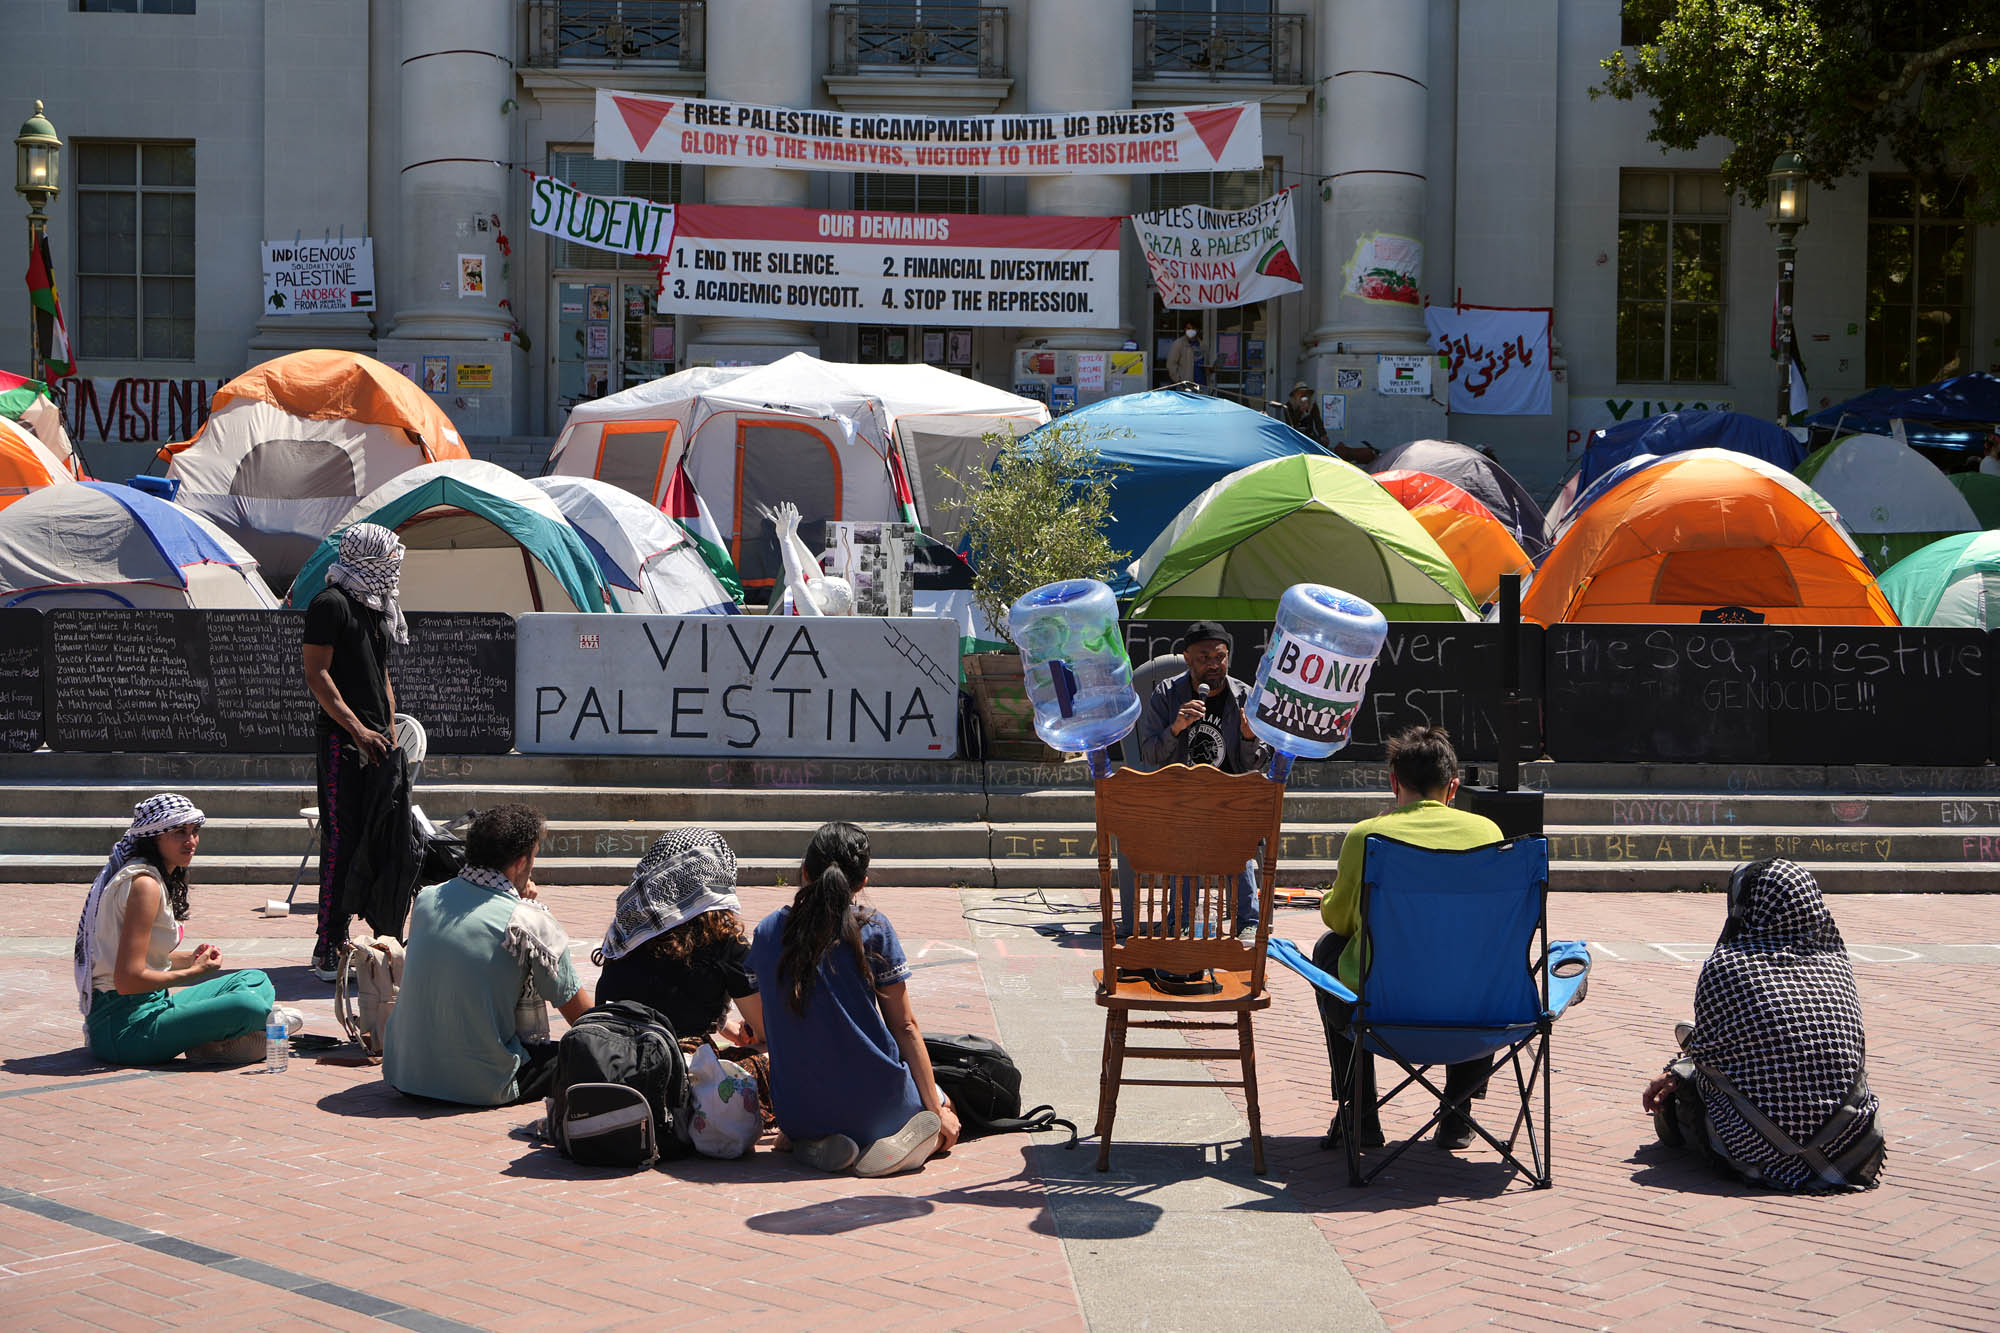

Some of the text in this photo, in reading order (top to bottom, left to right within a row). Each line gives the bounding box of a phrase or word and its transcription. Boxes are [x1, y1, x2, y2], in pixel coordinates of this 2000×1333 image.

[684, 102, 1174, 142] FREE PALESTINE ENCAMPMENT UNTIL UC DIVESTS
[681, 130, 1179, 167] GLORY TO THE MARTYRS, VICTORY TO THE RESISTANCE!
[531, 179, 672, 253] STUDENT
[818, 214, 950, 241] OUR DEMANDS
[1198, 199, 1279, 230] UNIVERSITY
[272, 246, 357, 263] INDIGENOUS
[1190, 238, 1202, 257] &
[291, 263, 335, 271] SOLIDARITY
[675, 247, 840, 276] 1. END THE SILENCE.
[882, 256, 1094, 282] 2. FINANCIAL DIVESTMENT.
[275, 268, 357, 288] PALESTINE
[294, 287, 347, 301] LANDBACK
[294, 300, 318, 311] FROM
[673, 279, 864, 308] 3. ACADEMIC BOYCOTT.
[881, 288, 1094, 313] 4. STOP THE REPRESSION.
[1198, 281, 1241, 304] NOW
[579, 641, 600, 649] GAZA
[642, 620, 828, 680] VIVA
[1555, 628, 1984, 682] the Sea, Palestine
[1276, 640, 1368, 693] BONK
[1703, 679, 1878, 716] GENOCIDE!!!
[535, 684, 938, 749] PALESTINA
[1612, 800, 1723, 825] BOYCOTT
[1941, 801, 1978, 824] END
[594, 833, 648, 854] REST
[1004, 834, 1081, 857] IF I
[1570, 836, 1594, 858] IT
[1605, 835, 1640, 861] BE
[1655, 836, 1674, 860] A
[1679, 836, 1756, 860] TALE
[1775, 837, 1801, 855] RIP
